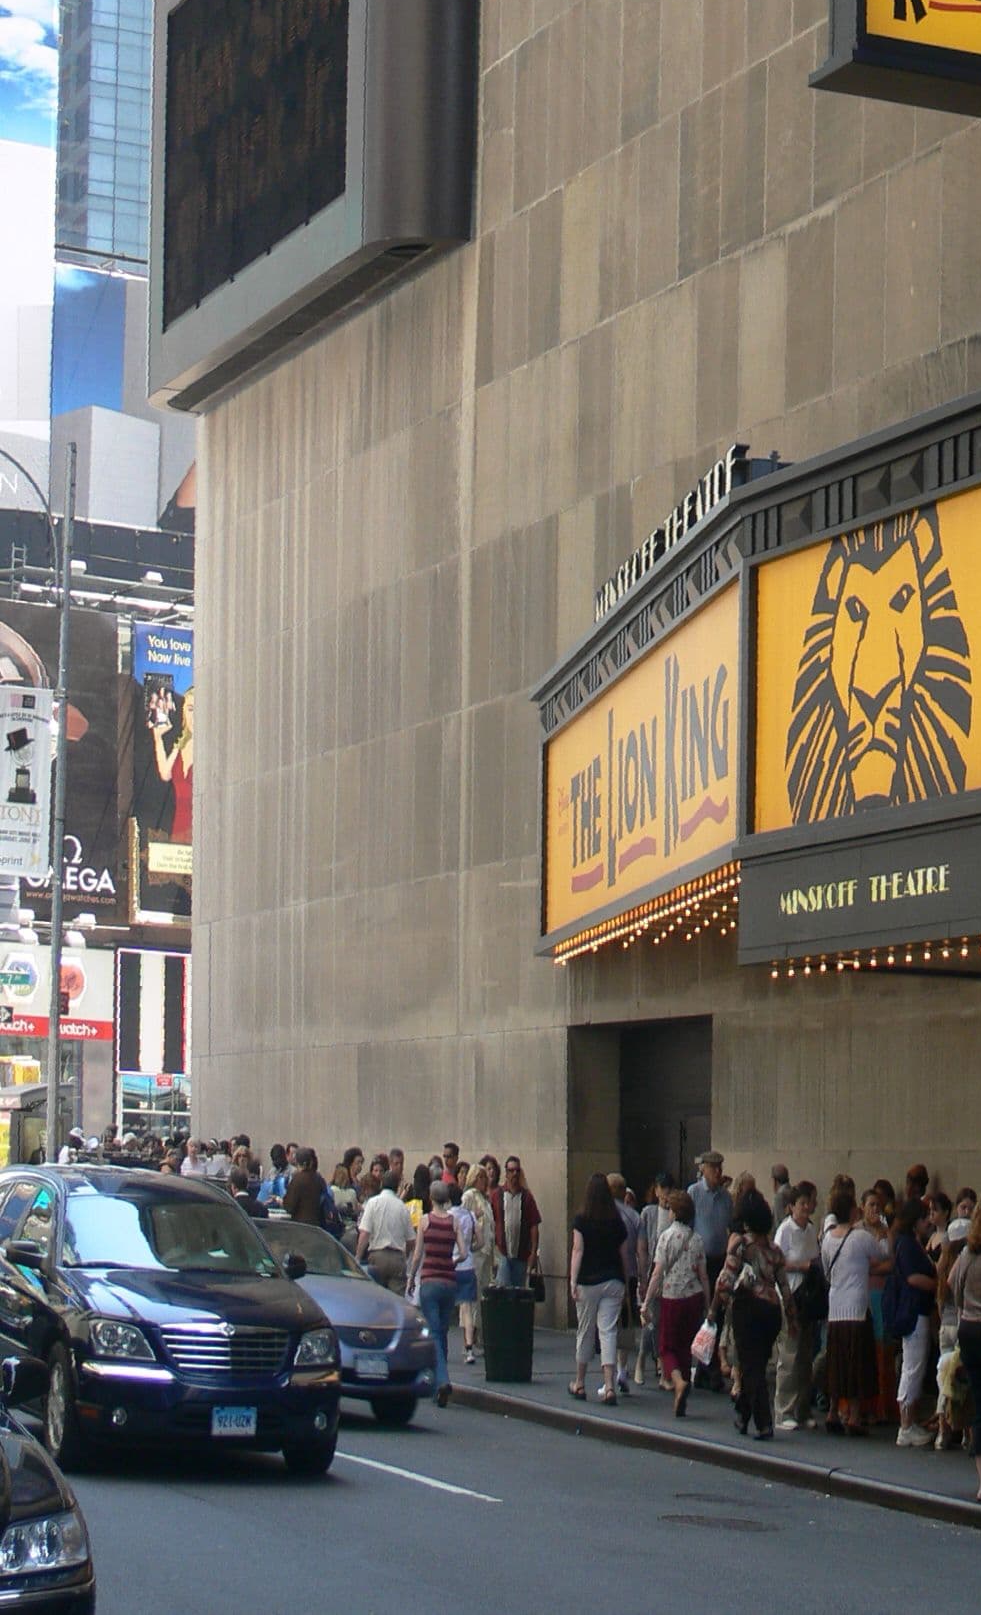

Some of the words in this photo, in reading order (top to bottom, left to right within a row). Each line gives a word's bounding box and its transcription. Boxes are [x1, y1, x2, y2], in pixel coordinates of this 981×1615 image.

[148, 635, 168, 649] You
[170, 638, 191, 652] love
[148, 649, 172, 665] Now
[173, 653, 191, 666] live
[571, 754, 601, 868] THE
[607, 707, 658, 889] LION
[664, 651, 730, 858] KING
[778, 878, 858, 918] MINSKOFF
[869, 864, 950, 903] THEATRE
